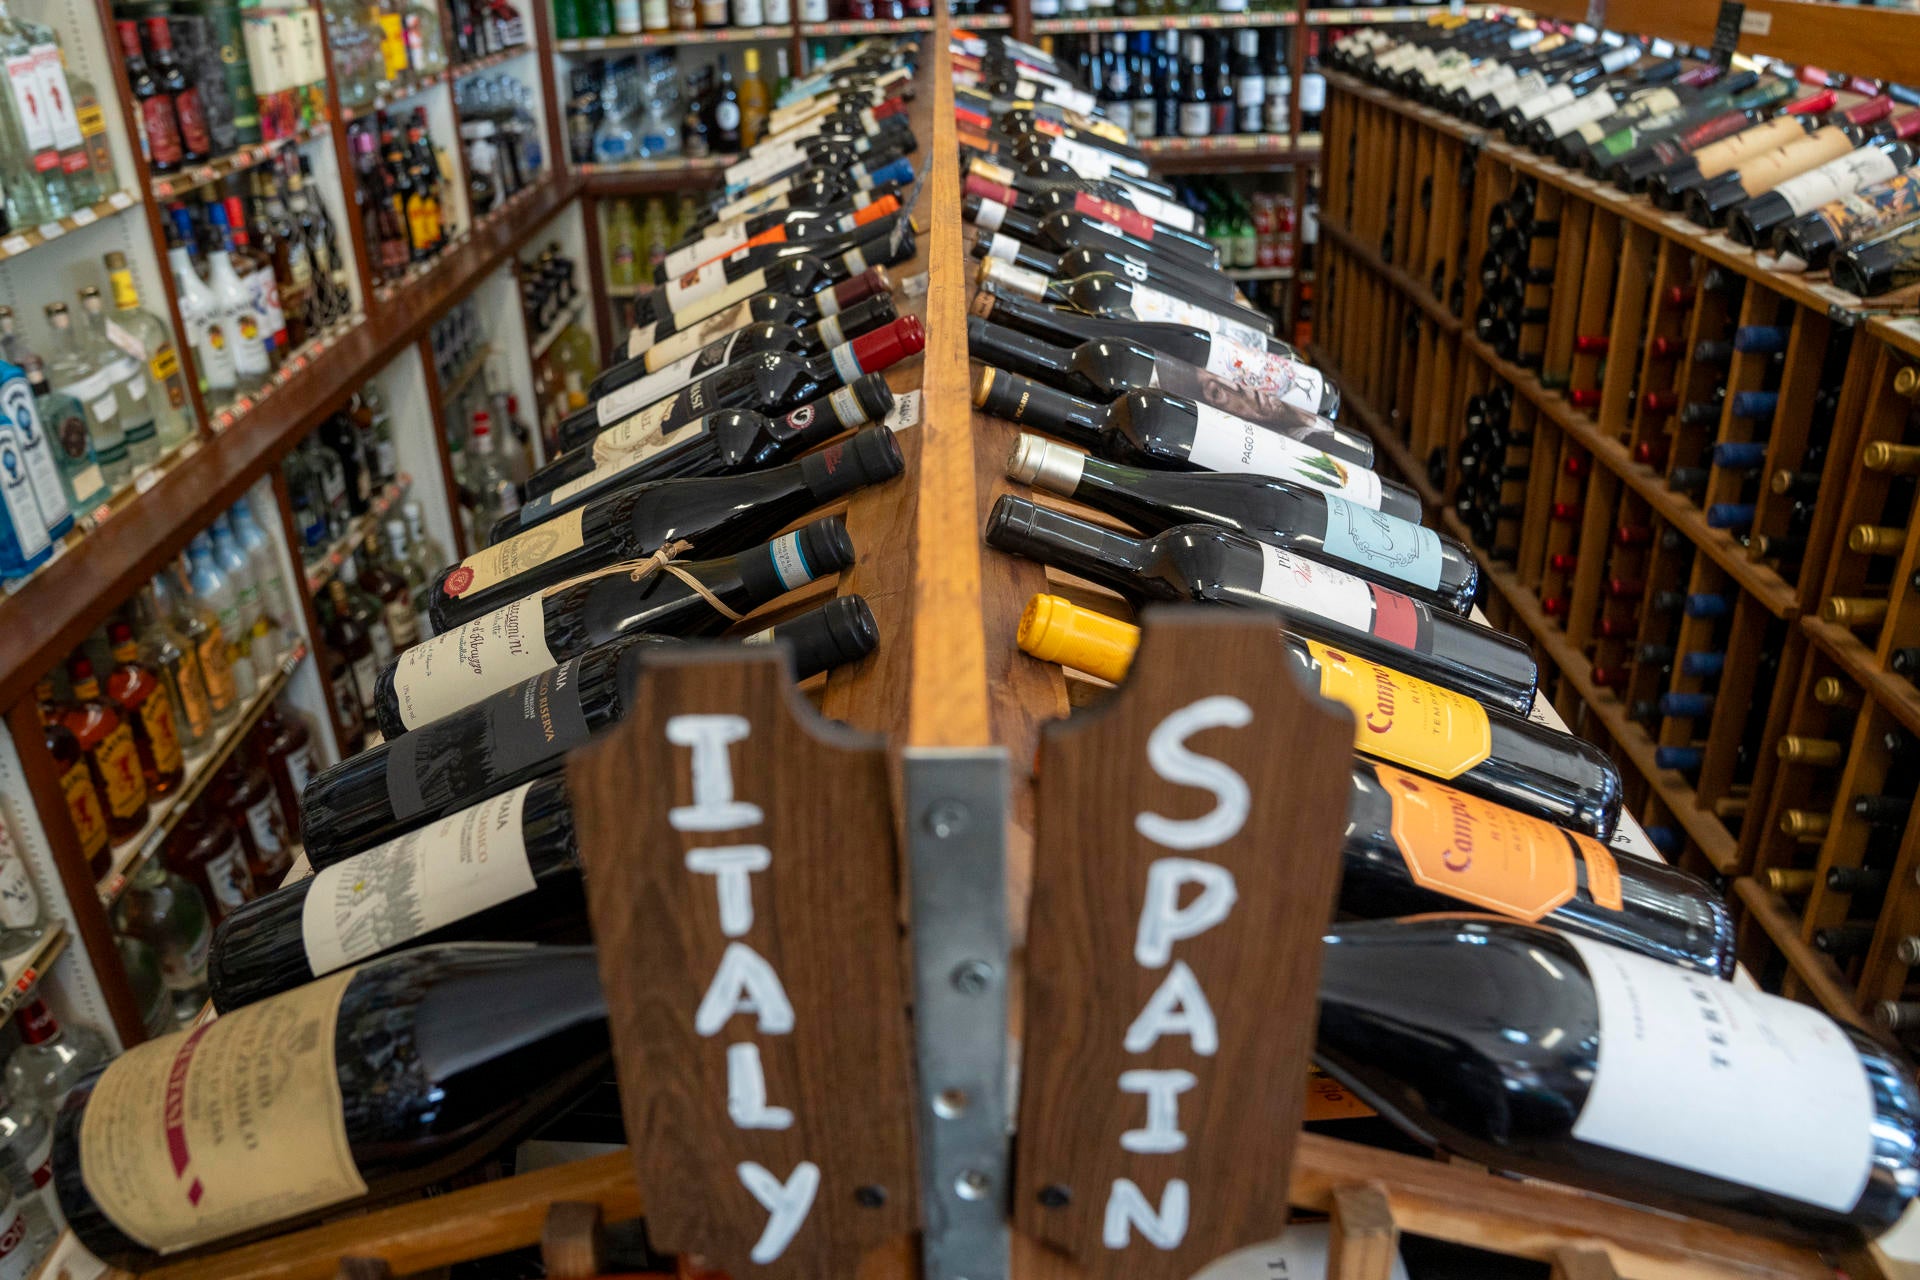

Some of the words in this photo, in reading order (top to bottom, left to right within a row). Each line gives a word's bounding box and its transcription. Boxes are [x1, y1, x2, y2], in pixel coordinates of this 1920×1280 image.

[1241, 436, 1254, 465] PAGO
[467, 627, 485, 675] d'Abruzzo
[1366, 667, 1400, 734] Campo
[1407, 680, 1421, 704] RIO
[1425, 681, 1442, 735] TEMPRA
[539, 697, 556, 742] RISERVA
[1442, 796, 1479, 873] Campo
[665, 714, 821, 1263] ITALY
[1102, 695, 1255, 1250] SPAIN
